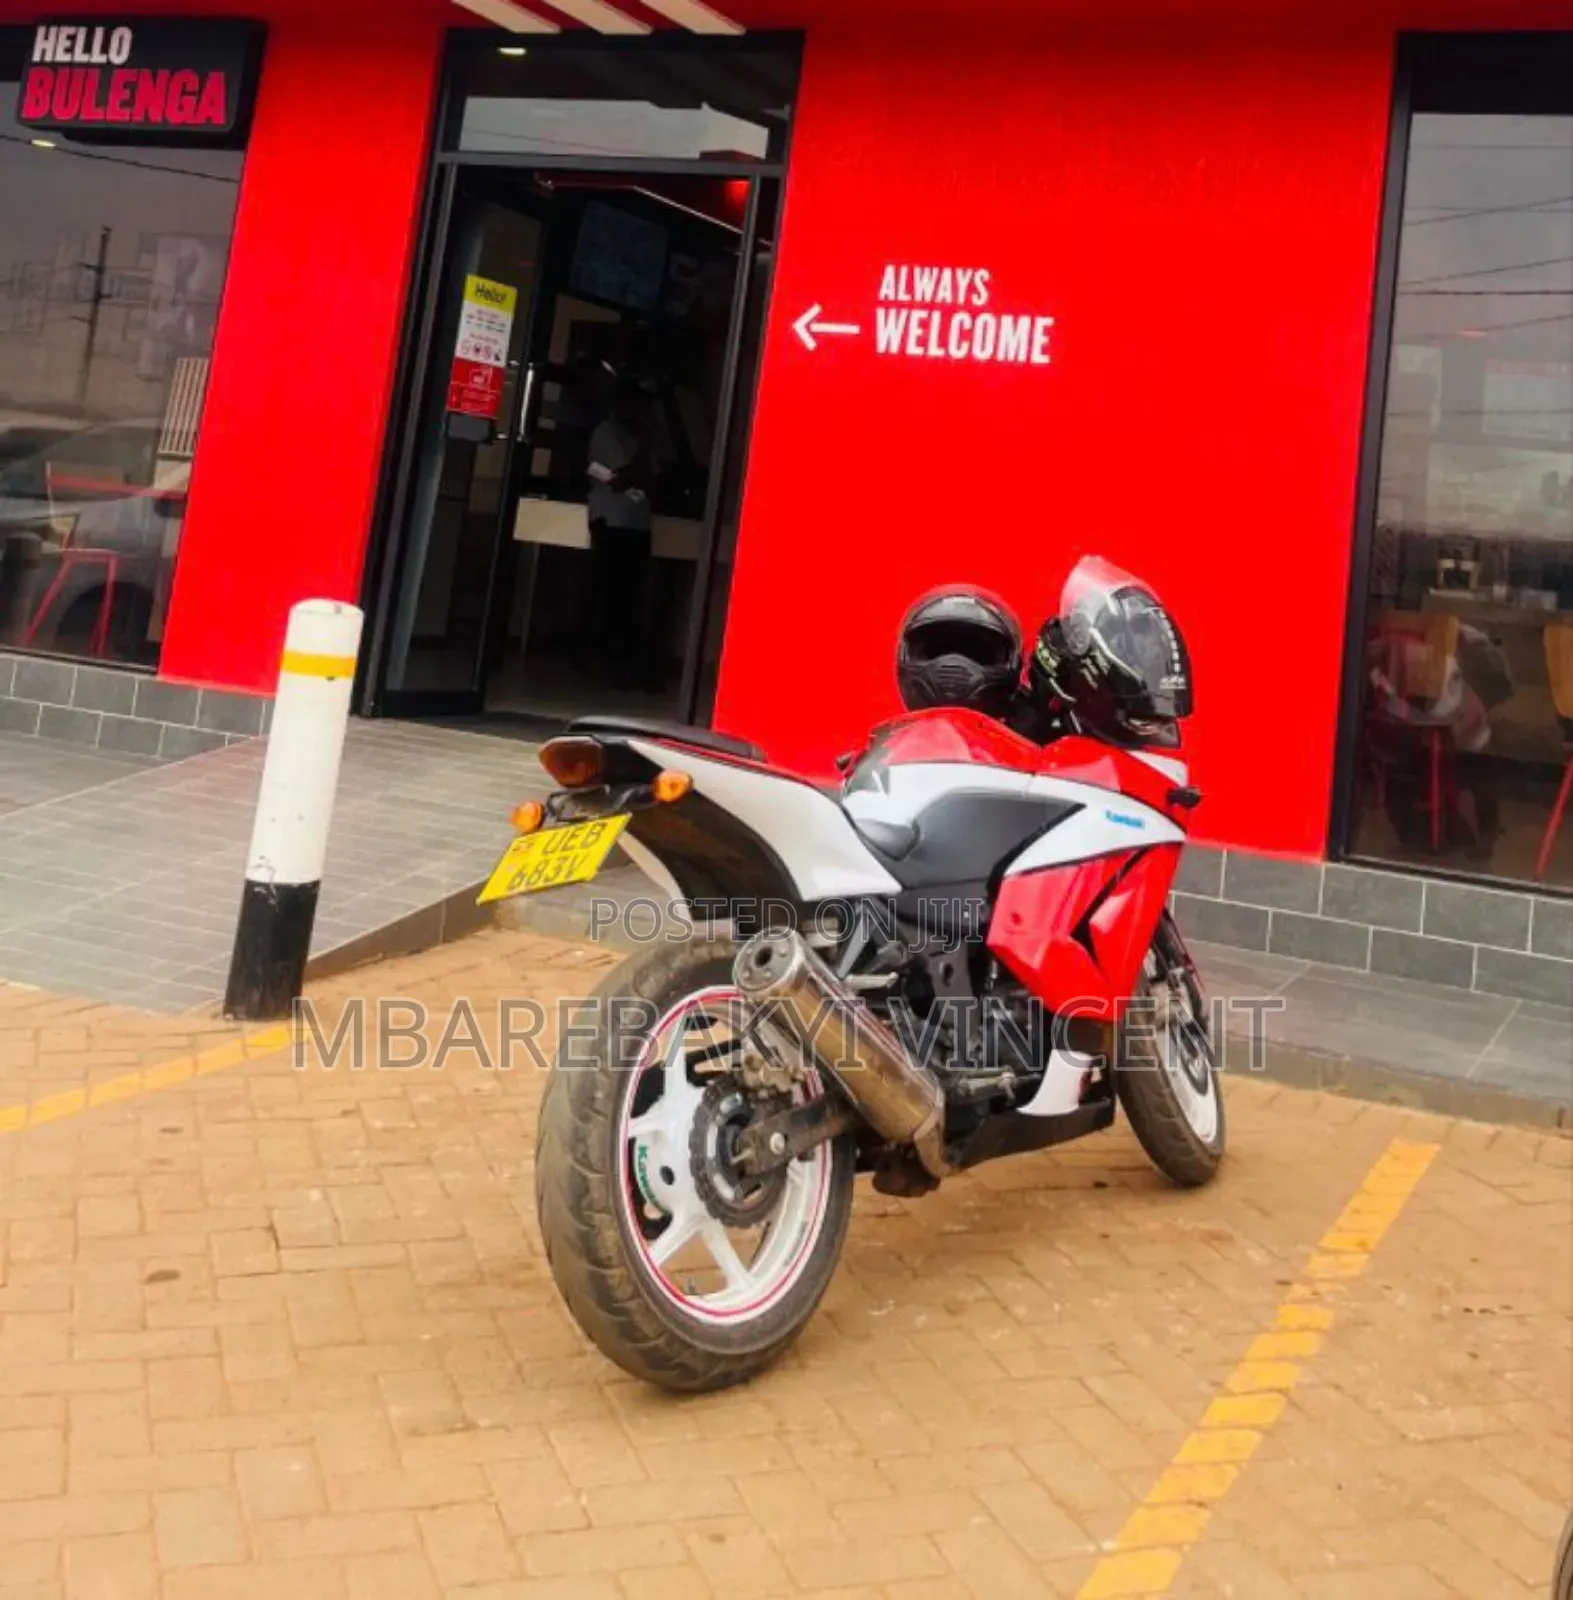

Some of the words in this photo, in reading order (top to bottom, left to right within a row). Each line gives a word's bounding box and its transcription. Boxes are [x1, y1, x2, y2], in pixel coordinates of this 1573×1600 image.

[32, 25, 133, 64] HELLO
[21, 67, 227, 125] BULENGA
[879, 264, 990, 306] ALWAYS
[876, 307, 1055, 364] WELCOME
[541, 821, 608, 856] UEB
[507, 851, 590, 890] 683V
